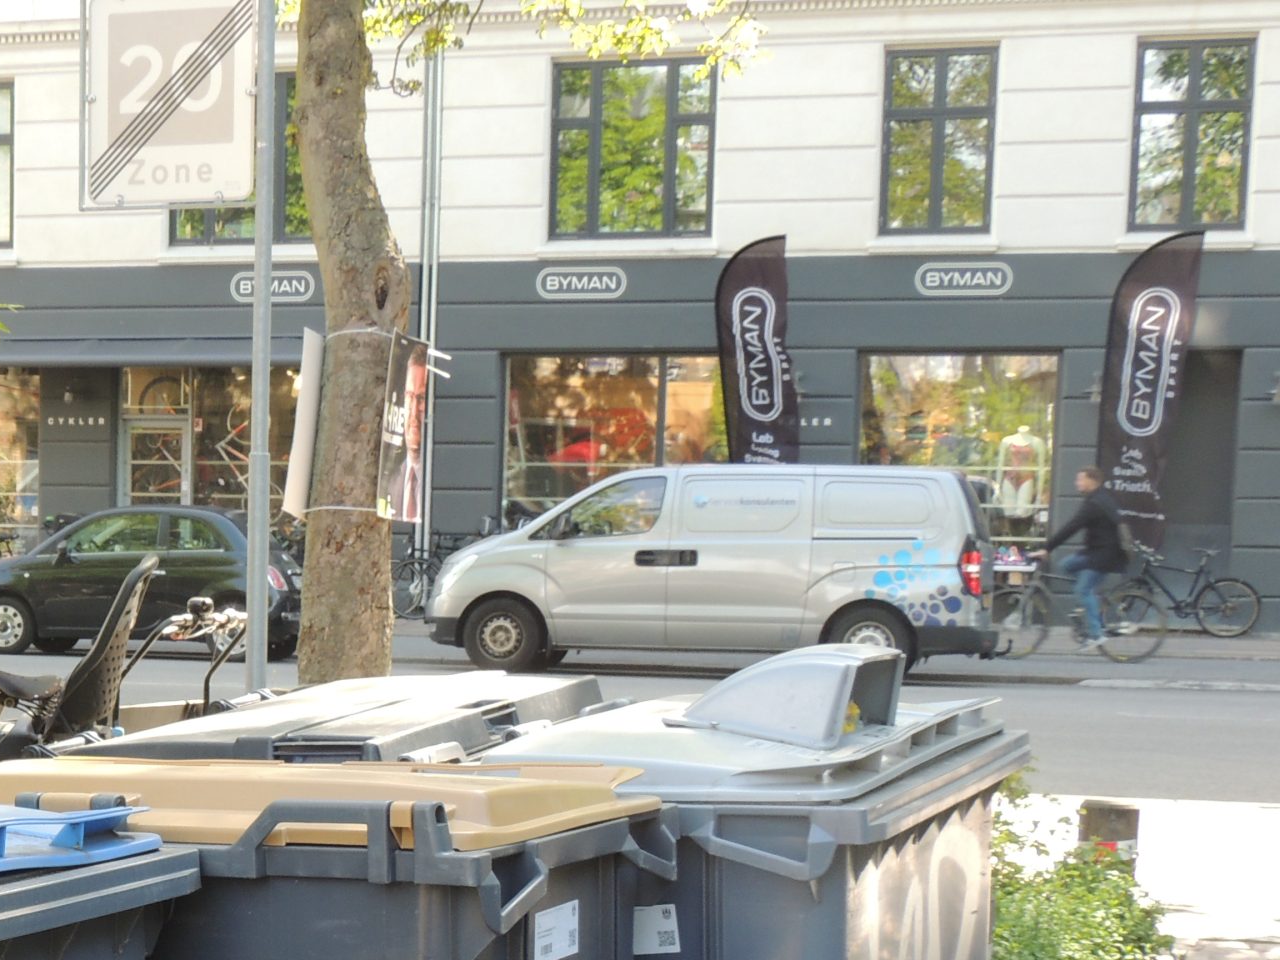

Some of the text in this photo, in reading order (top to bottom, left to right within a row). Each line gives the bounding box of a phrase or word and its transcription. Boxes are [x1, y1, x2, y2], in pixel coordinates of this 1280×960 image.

[119, 41, 223, 115] 20
[127, 159, 213, 185] Zone
[546, 275, 617, 290] BYMAN
[925, 271, 1002, 287] BYMAN
[743, 305, 770, 405] BYMAN
[1130, 306, 1167, 420] BYMAN
[47, 417, 105, 426] CYKLER
